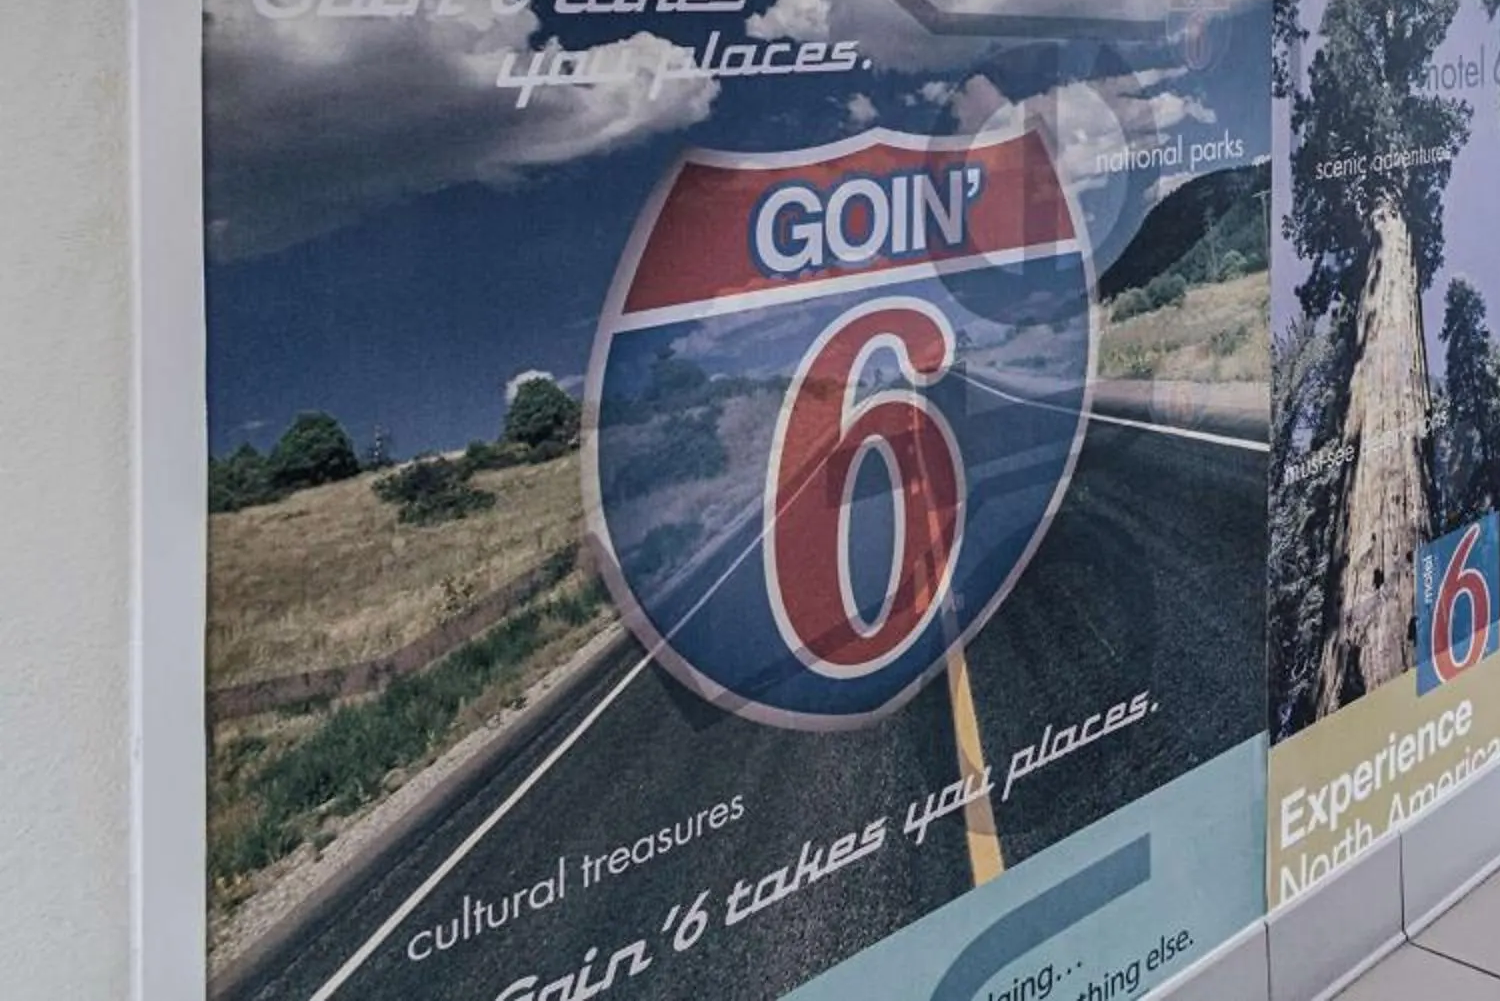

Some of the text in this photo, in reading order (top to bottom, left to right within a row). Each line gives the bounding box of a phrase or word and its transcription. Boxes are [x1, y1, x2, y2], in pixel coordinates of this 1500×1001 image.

[496, 31, 874, 109] you places.
[1095, 128, 1245, 175] national parks
[1314, 150, 1367, 180] scenic
[755, 167, 981, 274] GOIN'
[763, 296, 967, 679] 6
[1422, 554, 1433, 604] motel
[1431, 522, 1490, 684] 6
[724, 813, 886, 926] takes
[903, 770, 996, 845] you
[1002, 688, 1160, 801] places.
[1279, 698, 1474, 851] Experience
[408, 792, 745, 963] cultural treasures
[1279, 817, 1375, 904] North
[1146, 929, 1194, 972] else.
